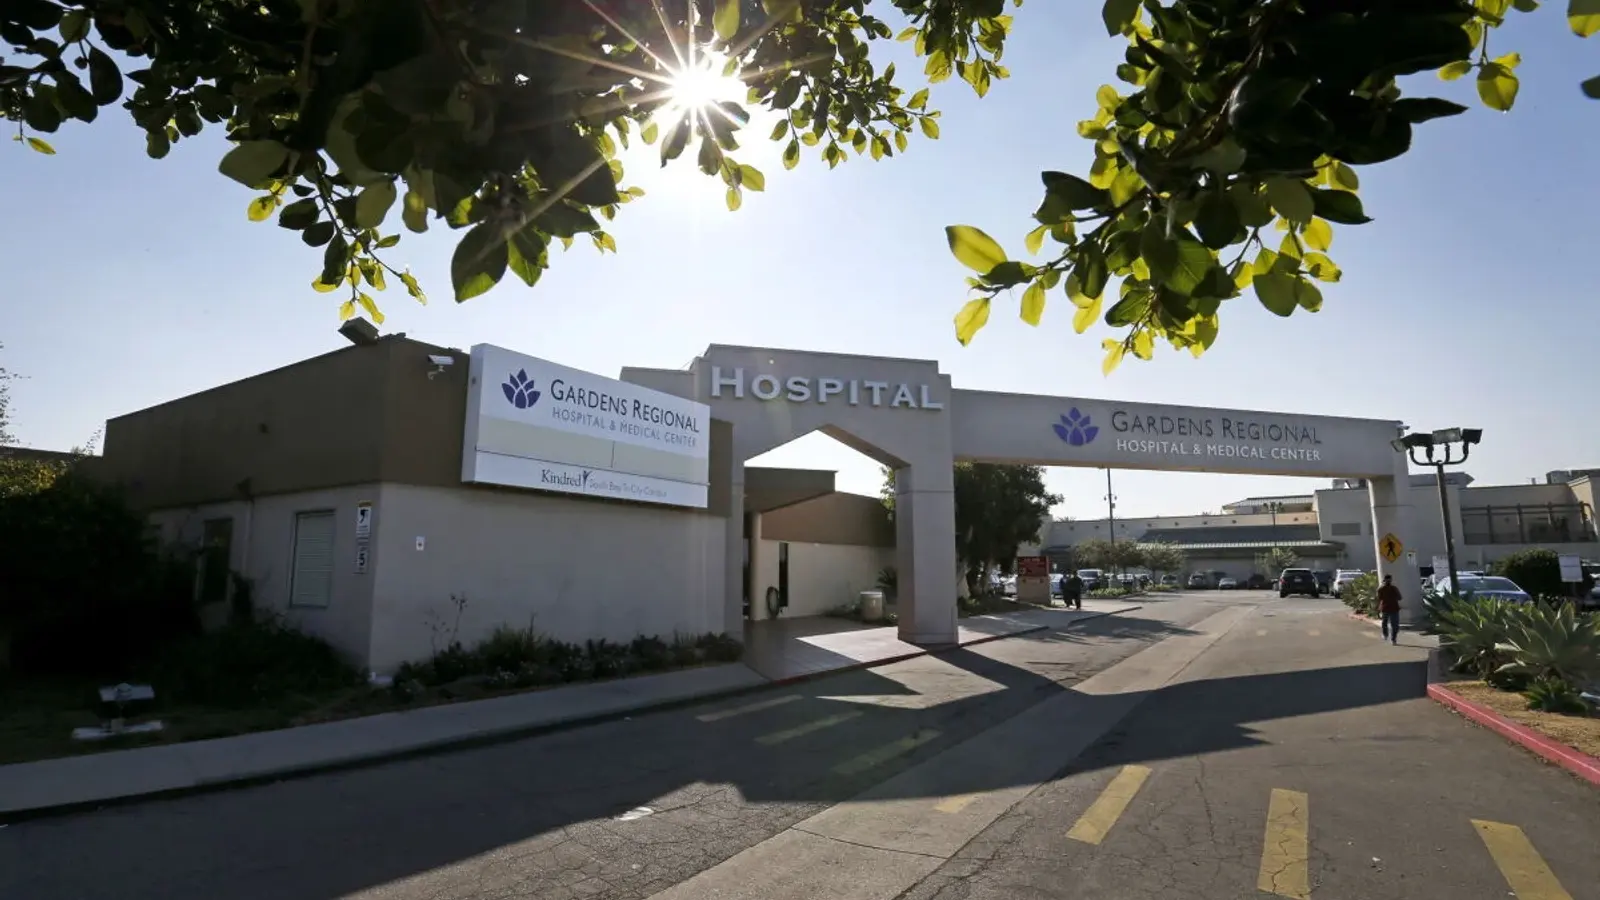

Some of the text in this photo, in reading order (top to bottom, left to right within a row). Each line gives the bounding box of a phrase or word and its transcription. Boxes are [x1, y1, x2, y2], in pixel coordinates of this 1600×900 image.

[550, 379, 700, 433] GARDENS REGIONAL
[711, 366, 944, 410] HOSPITAL
[552, 406, 696, 447] HOSPITAL & MEDICAL CENTER
[1112, 410, 1323, 444] GARDENS REGIONAL
[1117, 438, 1321, 461] HOSPITAL & MEDICAL CENTER
[541, 469, 582, 487] Kindred
